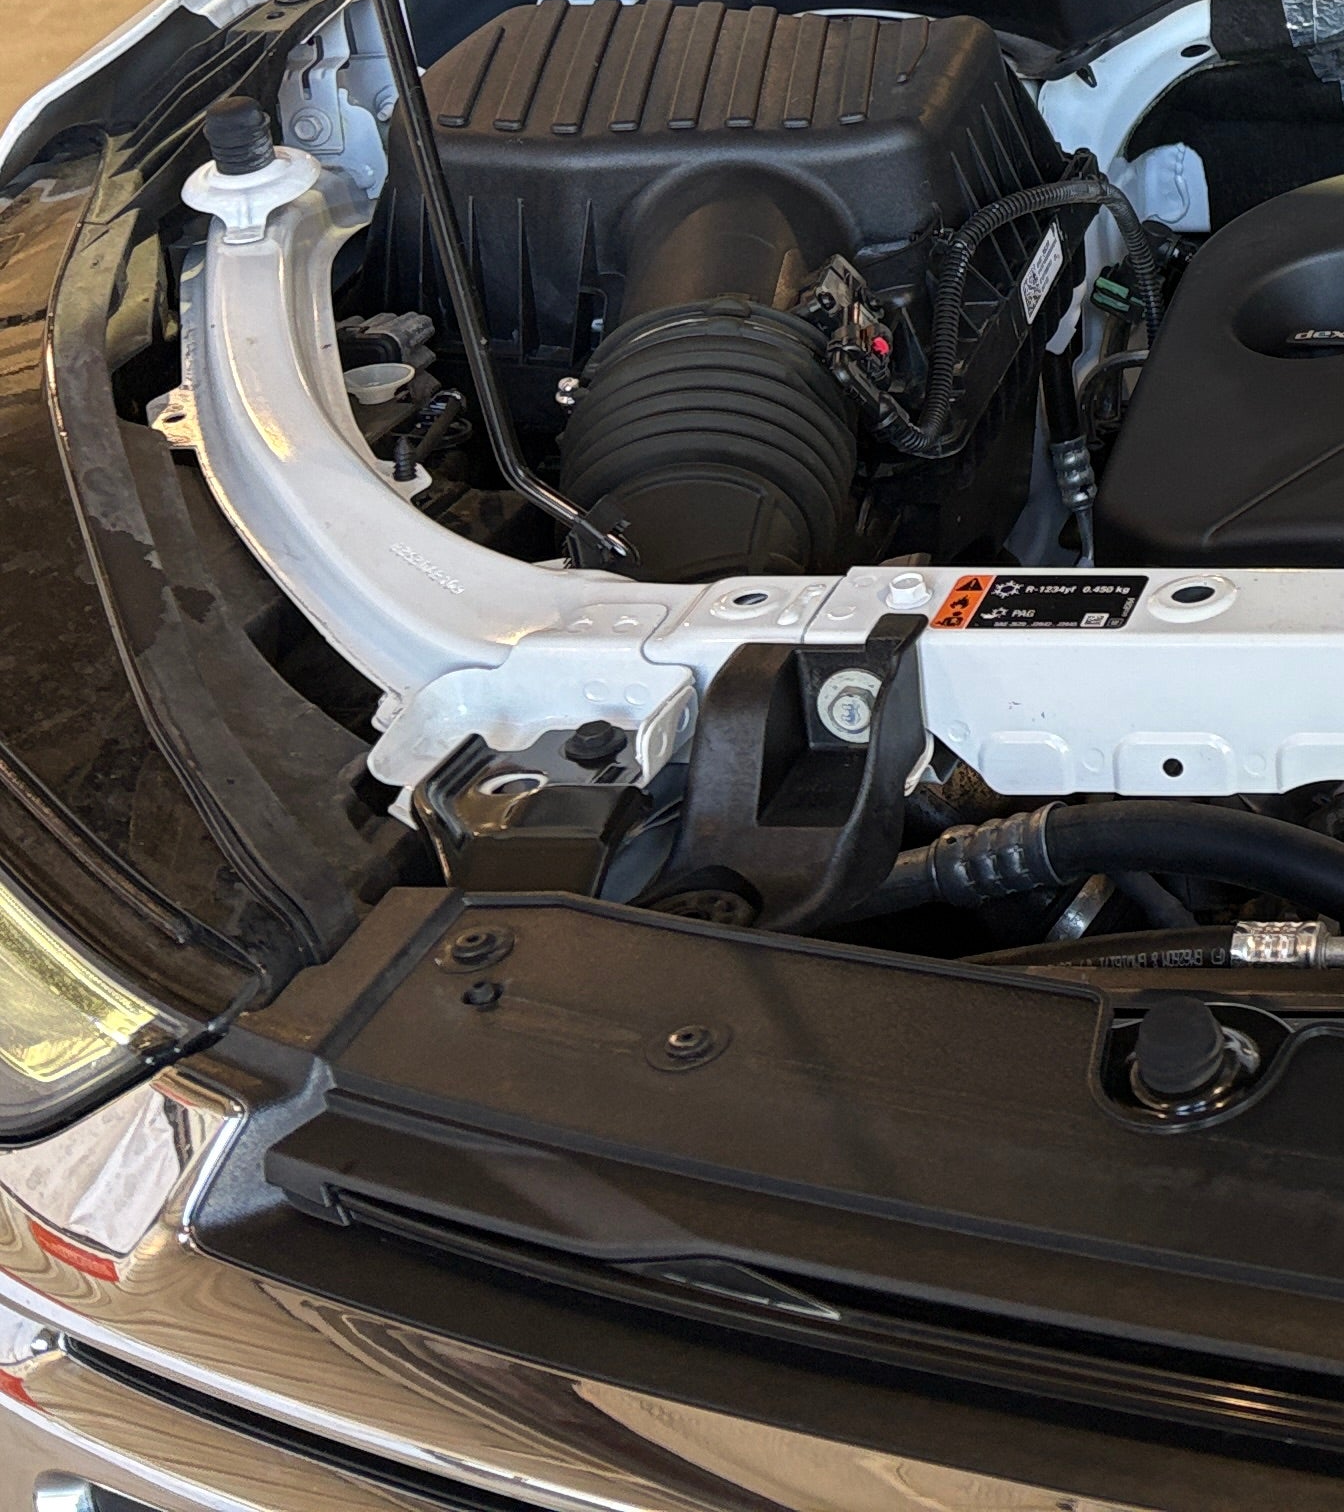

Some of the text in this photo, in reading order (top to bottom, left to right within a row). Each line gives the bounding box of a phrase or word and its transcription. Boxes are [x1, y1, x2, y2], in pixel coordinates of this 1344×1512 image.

[1024, 585, 1077, 595] R-1234yf
[1115, 585, 1131, 595] kg
[1011, 609, 1036, 618] PAG
